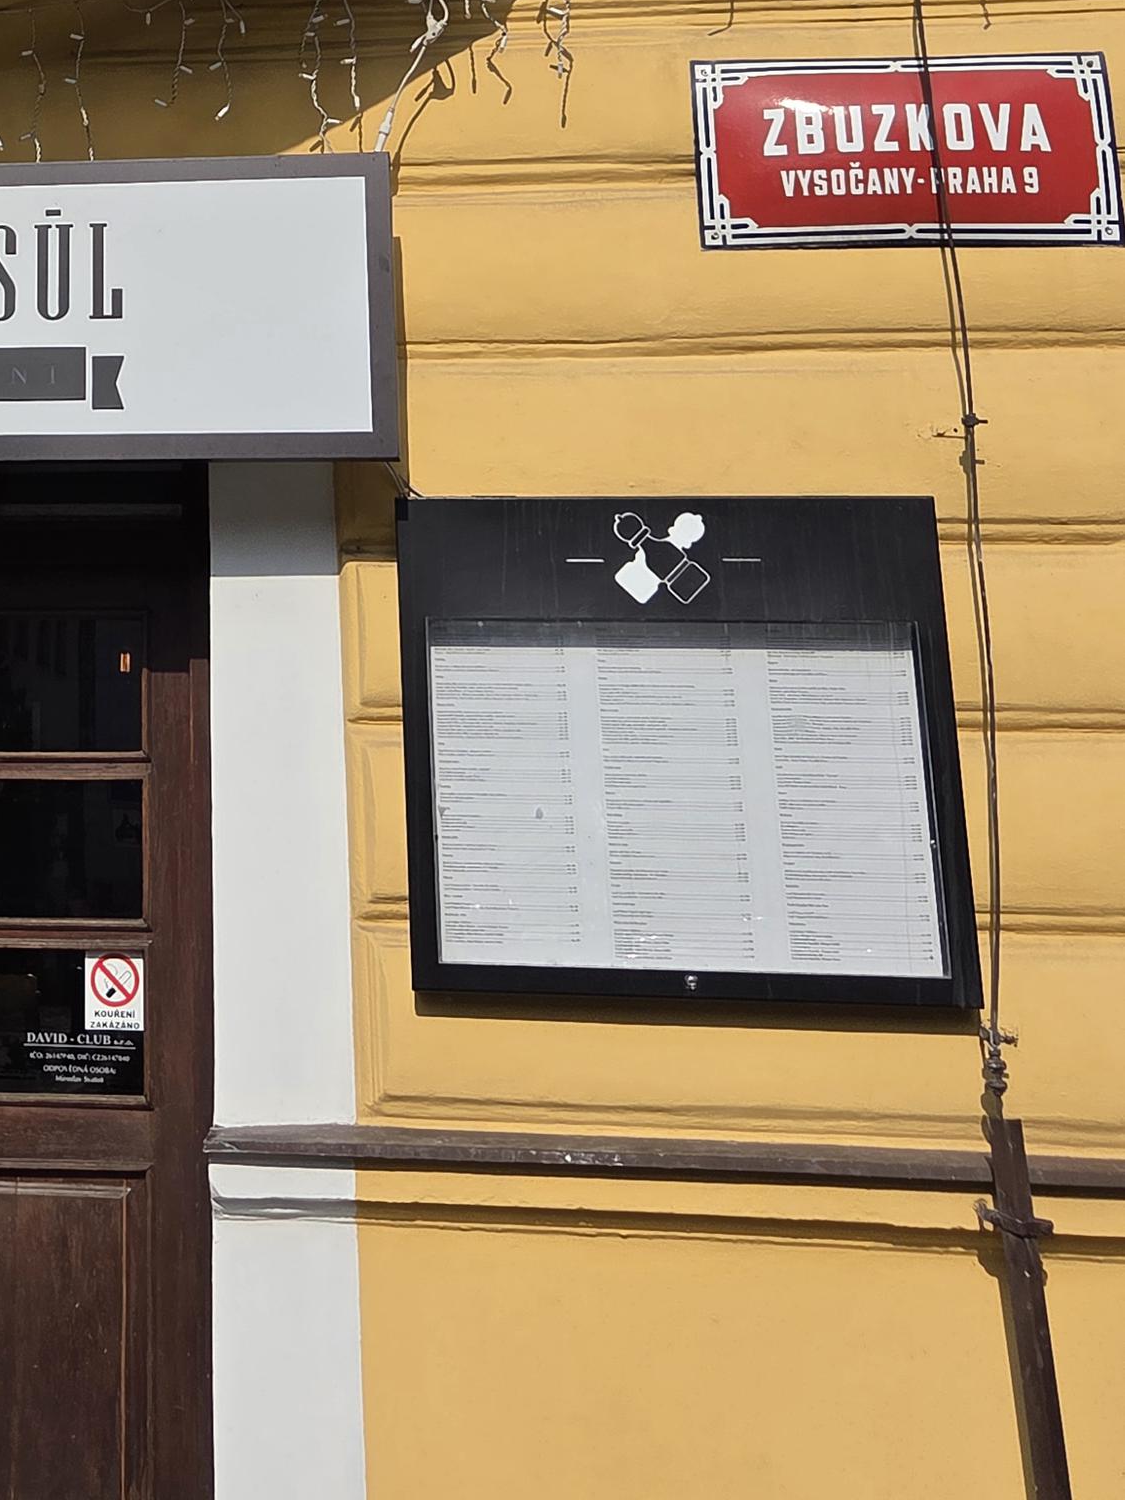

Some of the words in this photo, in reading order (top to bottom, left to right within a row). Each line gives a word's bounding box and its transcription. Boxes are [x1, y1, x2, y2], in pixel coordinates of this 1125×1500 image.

[763, 103, 1052, 156] ZBUZKOVA
[1023, 166, 1039, 194] 9
[94, 1009, 135, 1019] KOUŘENÍ
[27, 1032, 68, 1044] DAVID
[77, 1034, 112, 1045] CLUB
